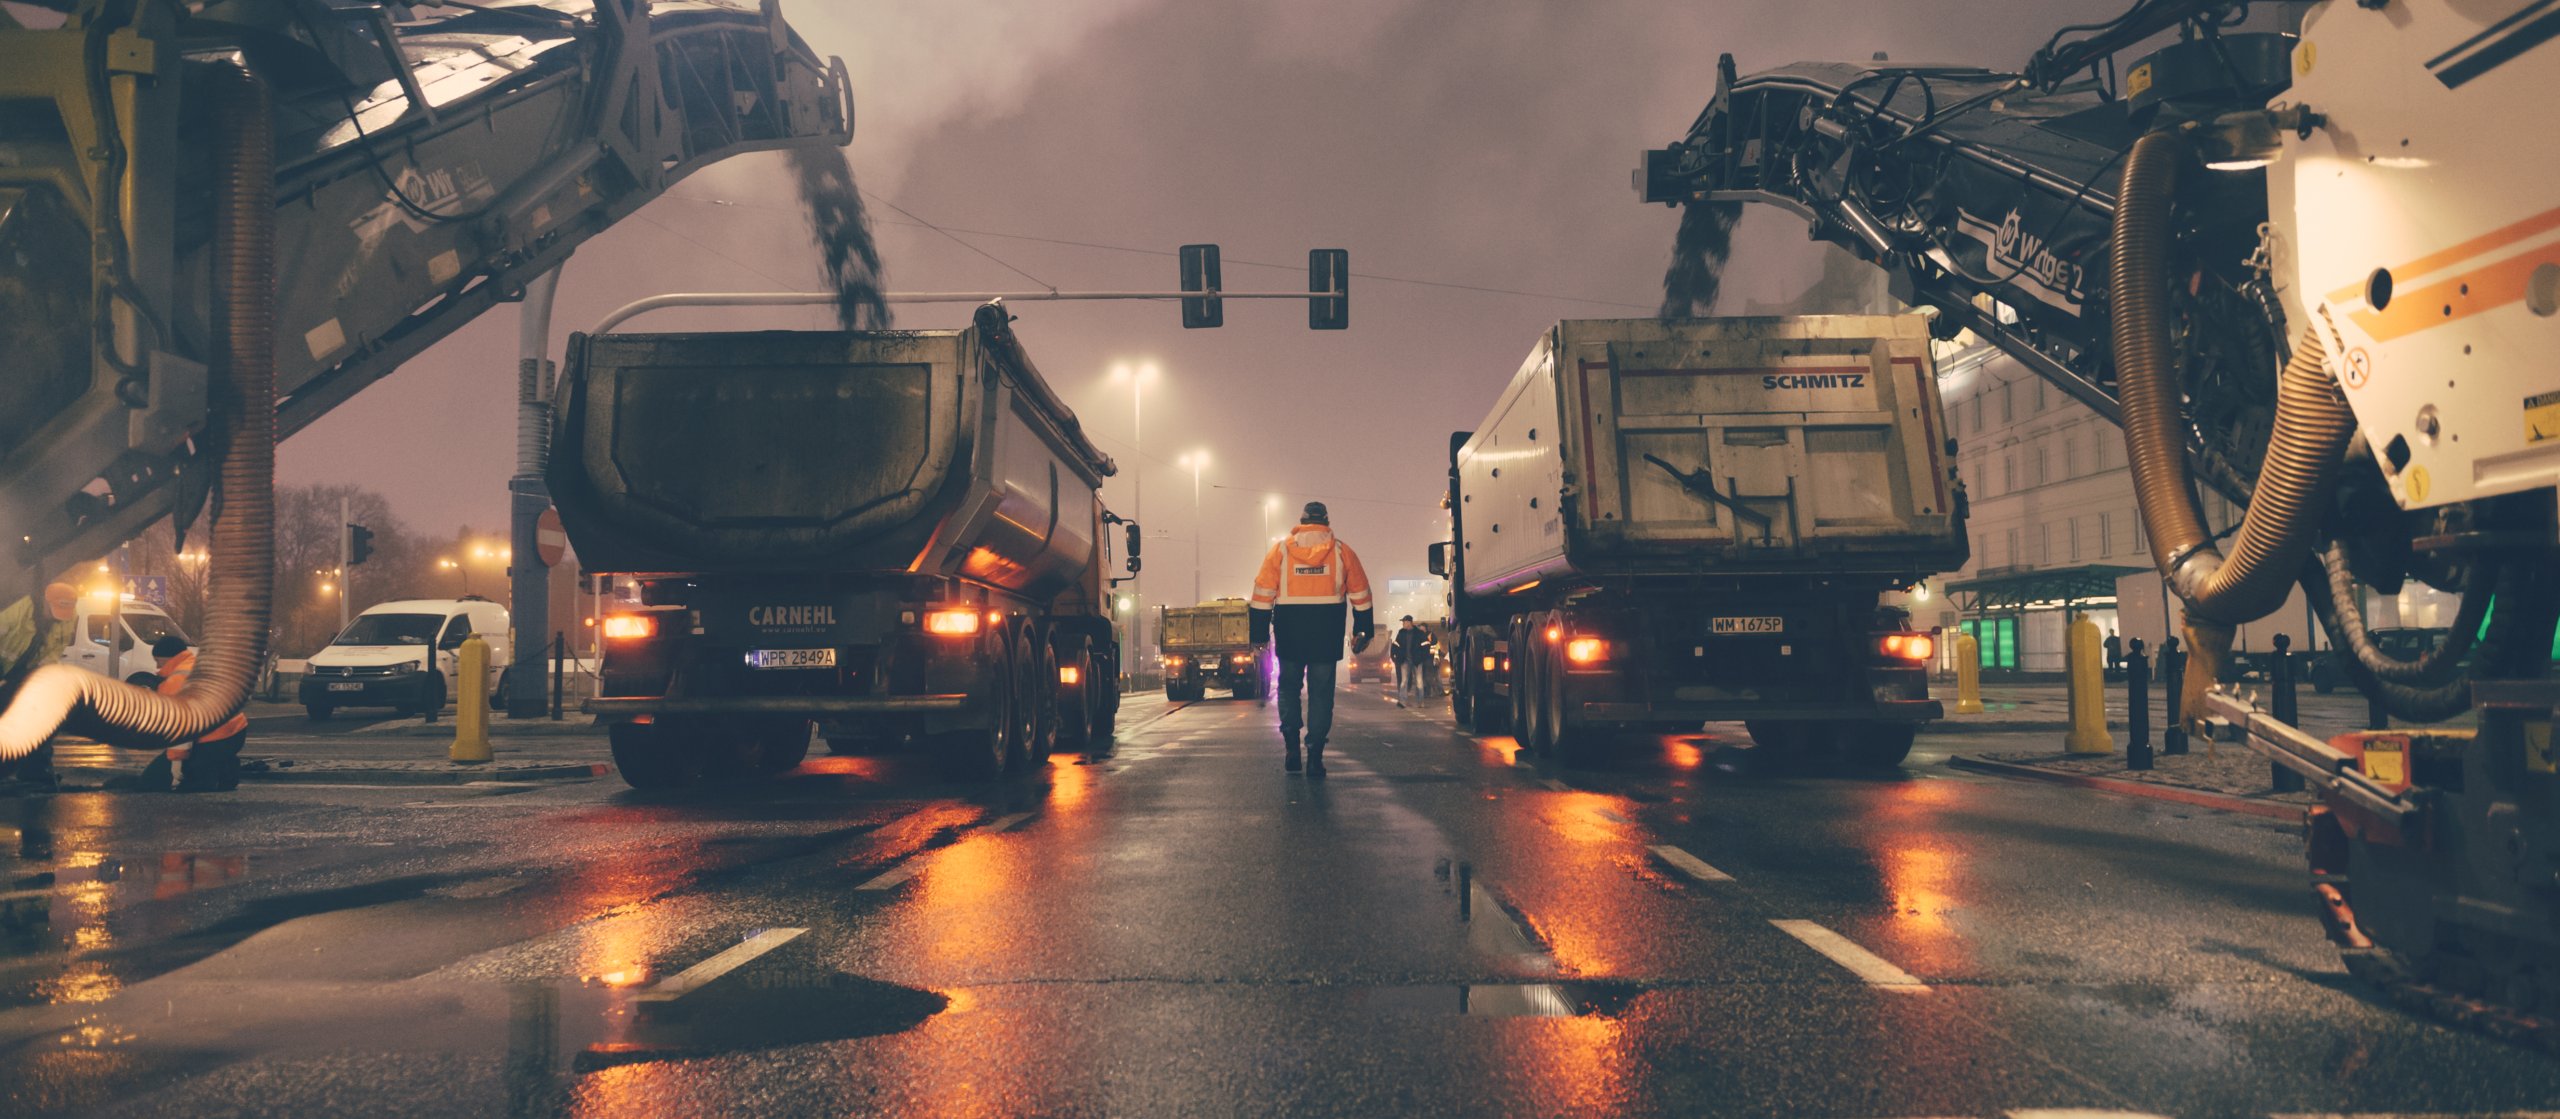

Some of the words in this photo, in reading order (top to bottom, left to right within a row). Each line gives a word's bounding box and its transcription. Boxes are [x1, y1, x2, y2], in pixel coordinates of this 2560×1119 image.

[1762, 374, 1865, 390] SCHMITZ
[748, 606, 837, 626] CARNEHL
[1715, 618, 1735, 632] WM
[1740, 618, 1781, 632] 1675P
[761, 651, 787, 666] WPR
[792, 650, 833, 665] 2849A
